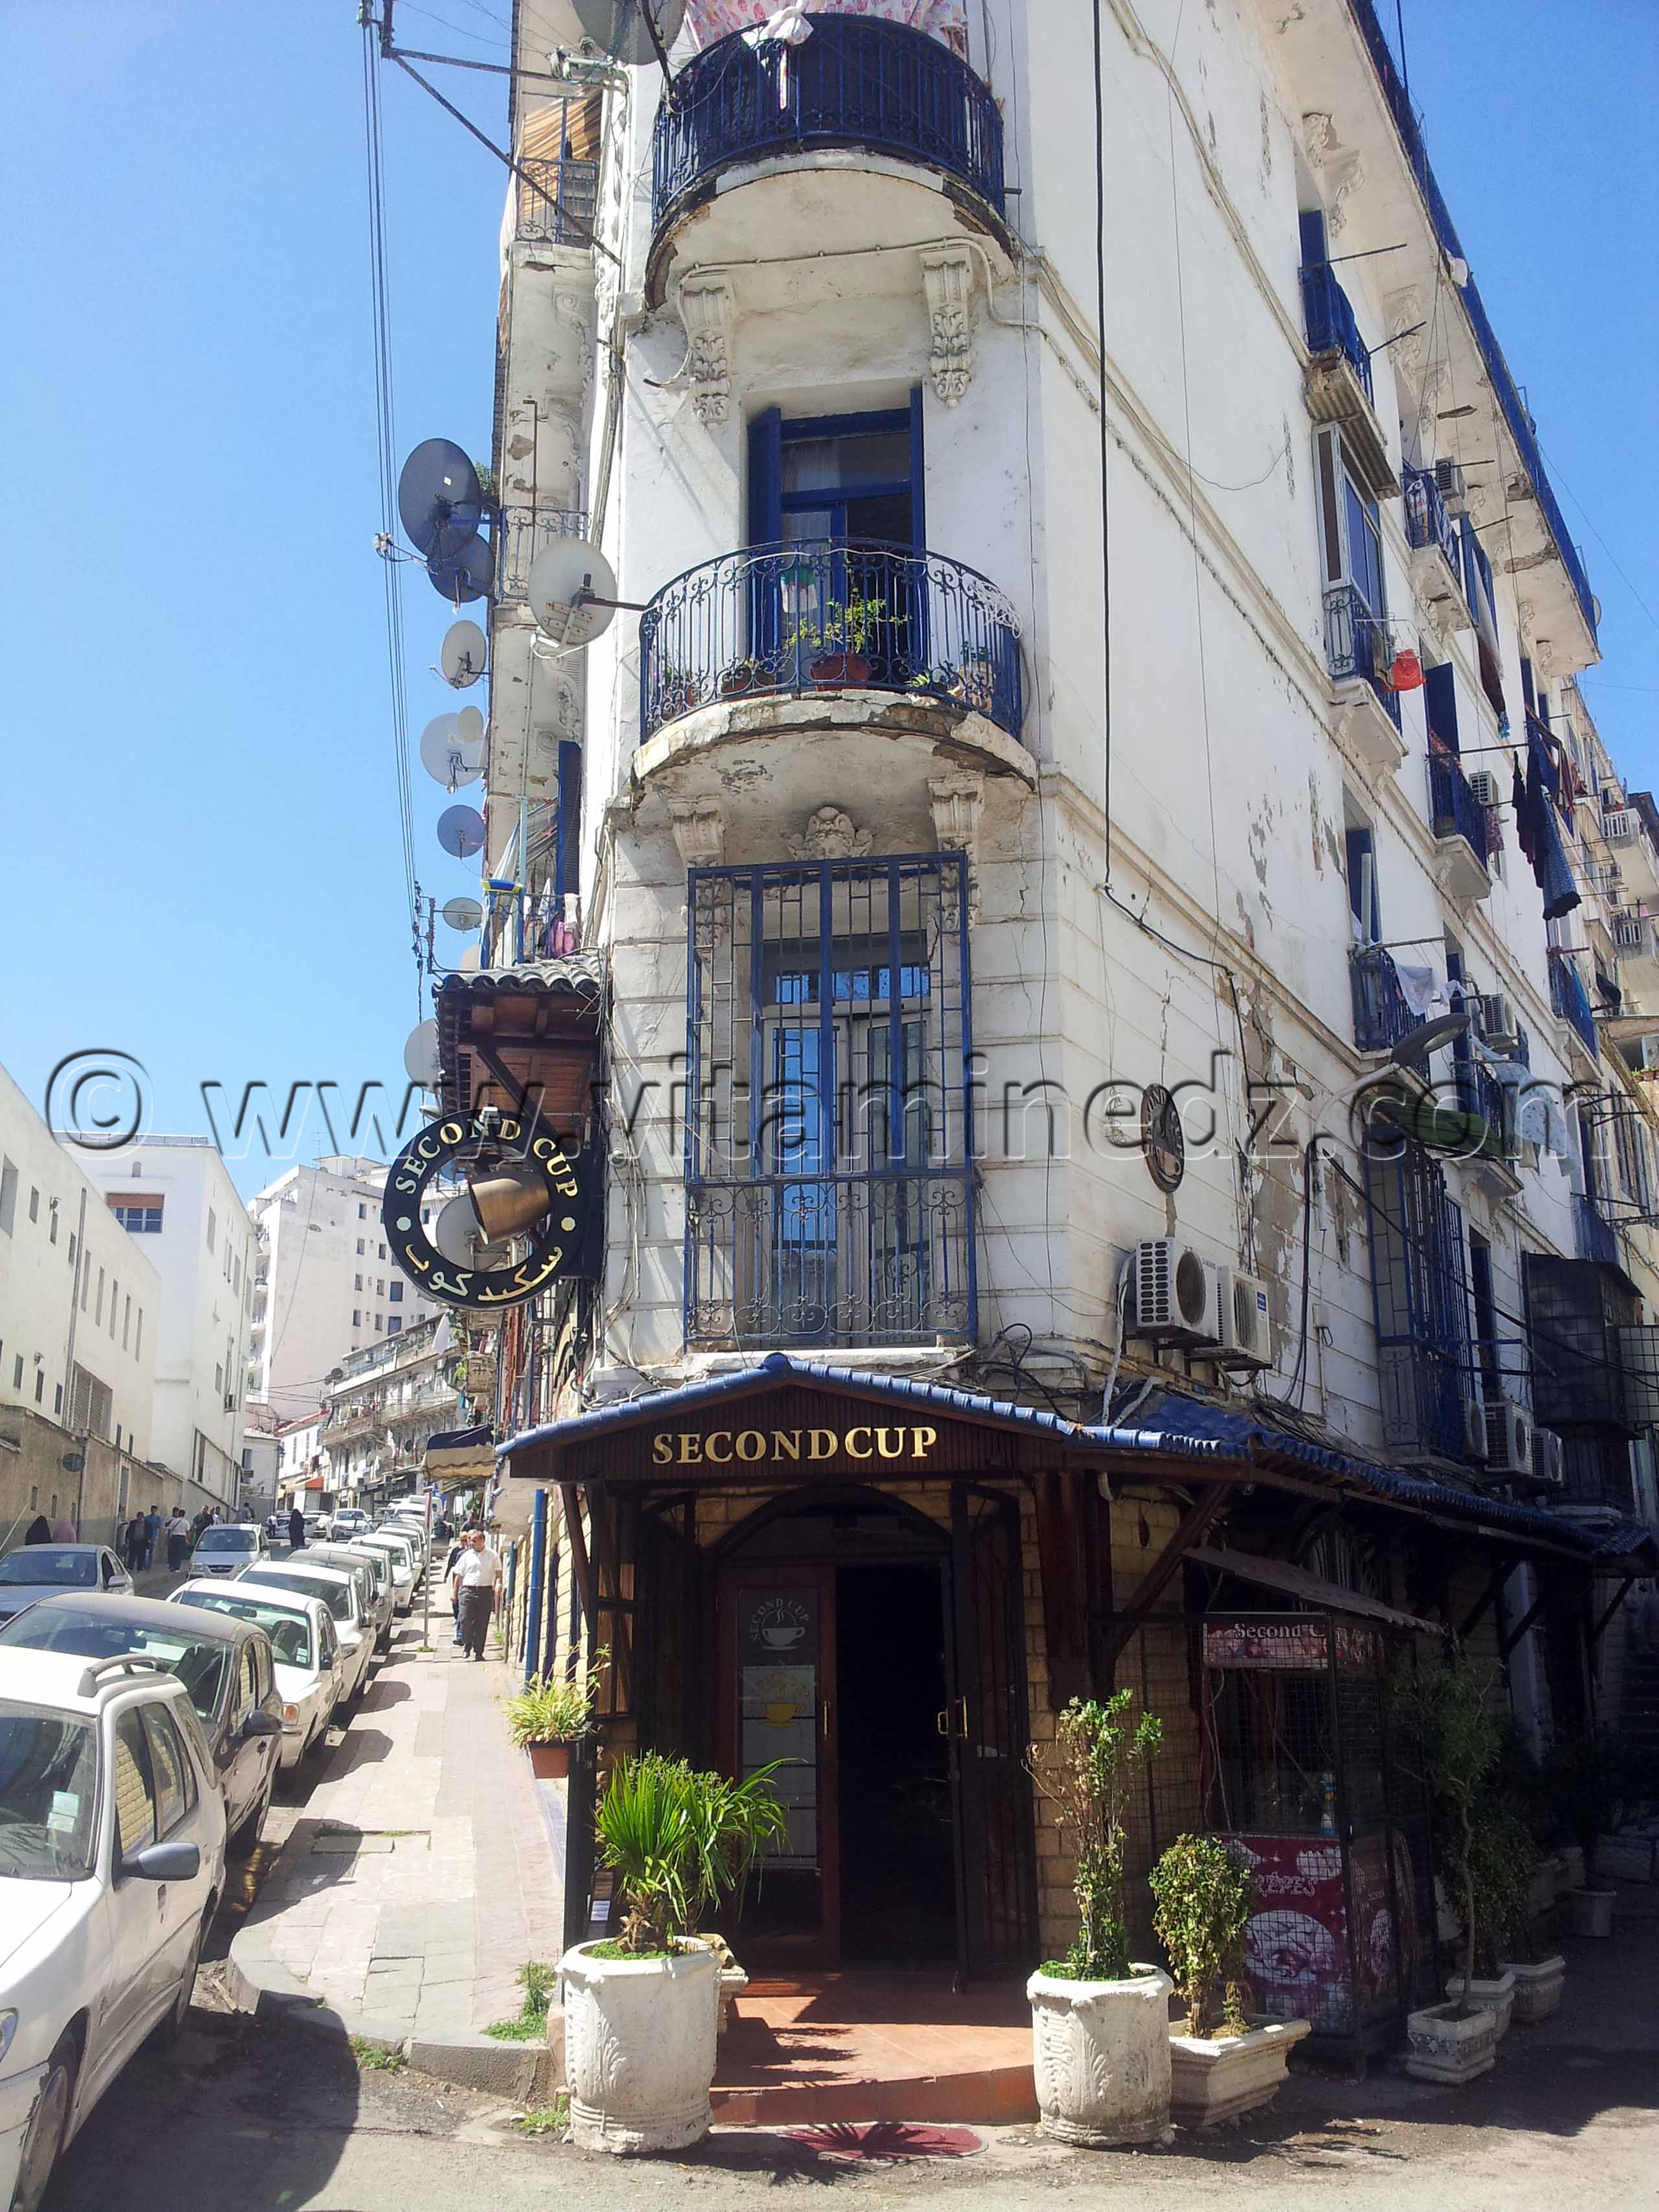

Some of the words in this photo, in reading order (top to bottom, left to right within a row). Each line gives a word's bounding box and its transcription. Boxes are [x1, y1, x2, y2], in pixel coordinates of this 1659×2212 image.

[395, 1117, 521, 1195] SECOND
[532, 1137, 579, 1198] CUP
[749, 1597, 783, 1644] SECOND
[787, 1600, 810, 1622] CUP
[1234, 1622, 1301, 1639] Second
